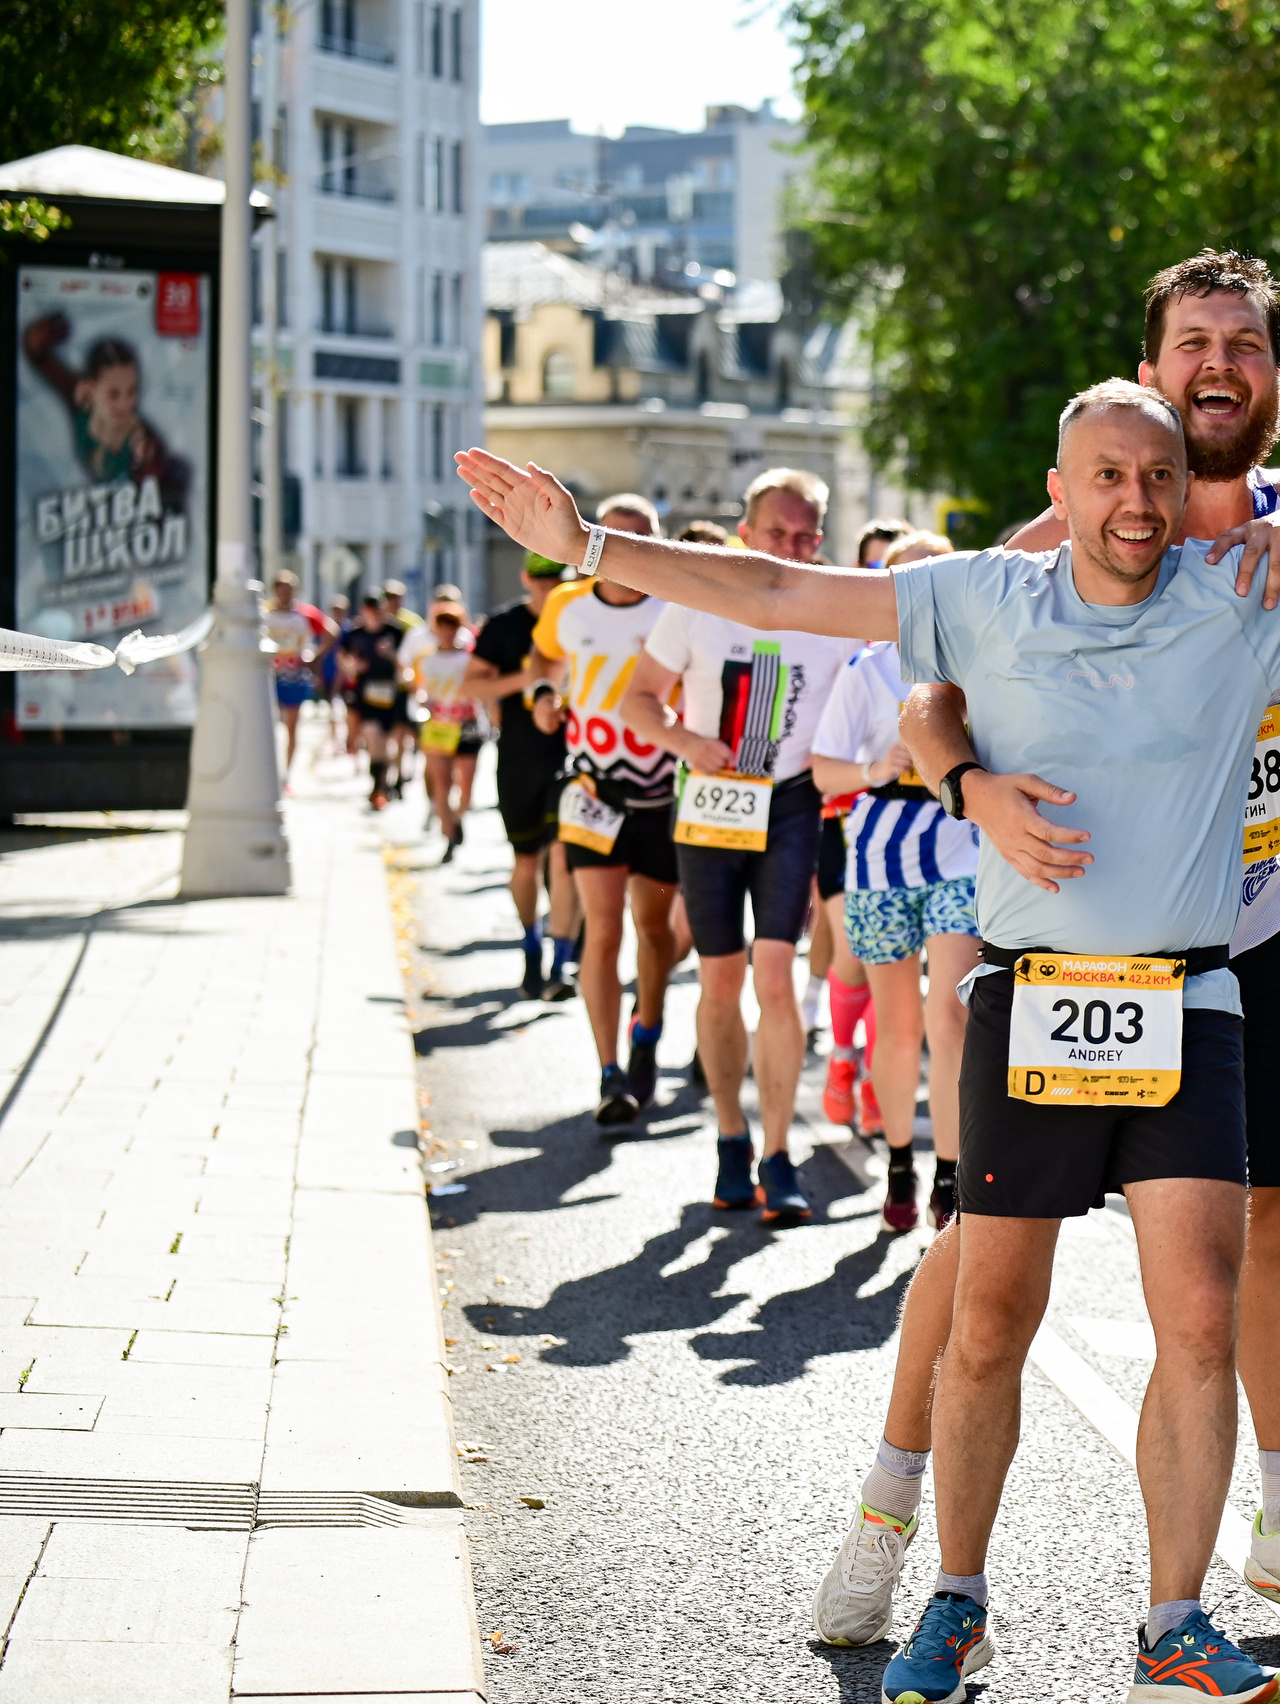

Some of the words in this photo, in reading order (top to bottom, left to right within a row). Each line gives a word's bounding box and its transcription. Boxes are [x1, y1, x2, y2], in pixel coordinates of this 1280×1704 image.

[37, 475, 162, 539] БИТВА
[65, 516, 186, 577] ШКОЛ
[694, 785, 756, 815] 6923
[1062, 960, 1127, 972] МАРАФОН
[1062, 972, 1116, 983] МОСКВА
[1128, 974, 1151, 984] 42,2
[1153, 975, 1171, 985] КМ
[1050, 998, 1144, 1045] 203
[1068, 1048, 1124, 1062] ANDREY
[1025, 1070, 1046, 1096] D
